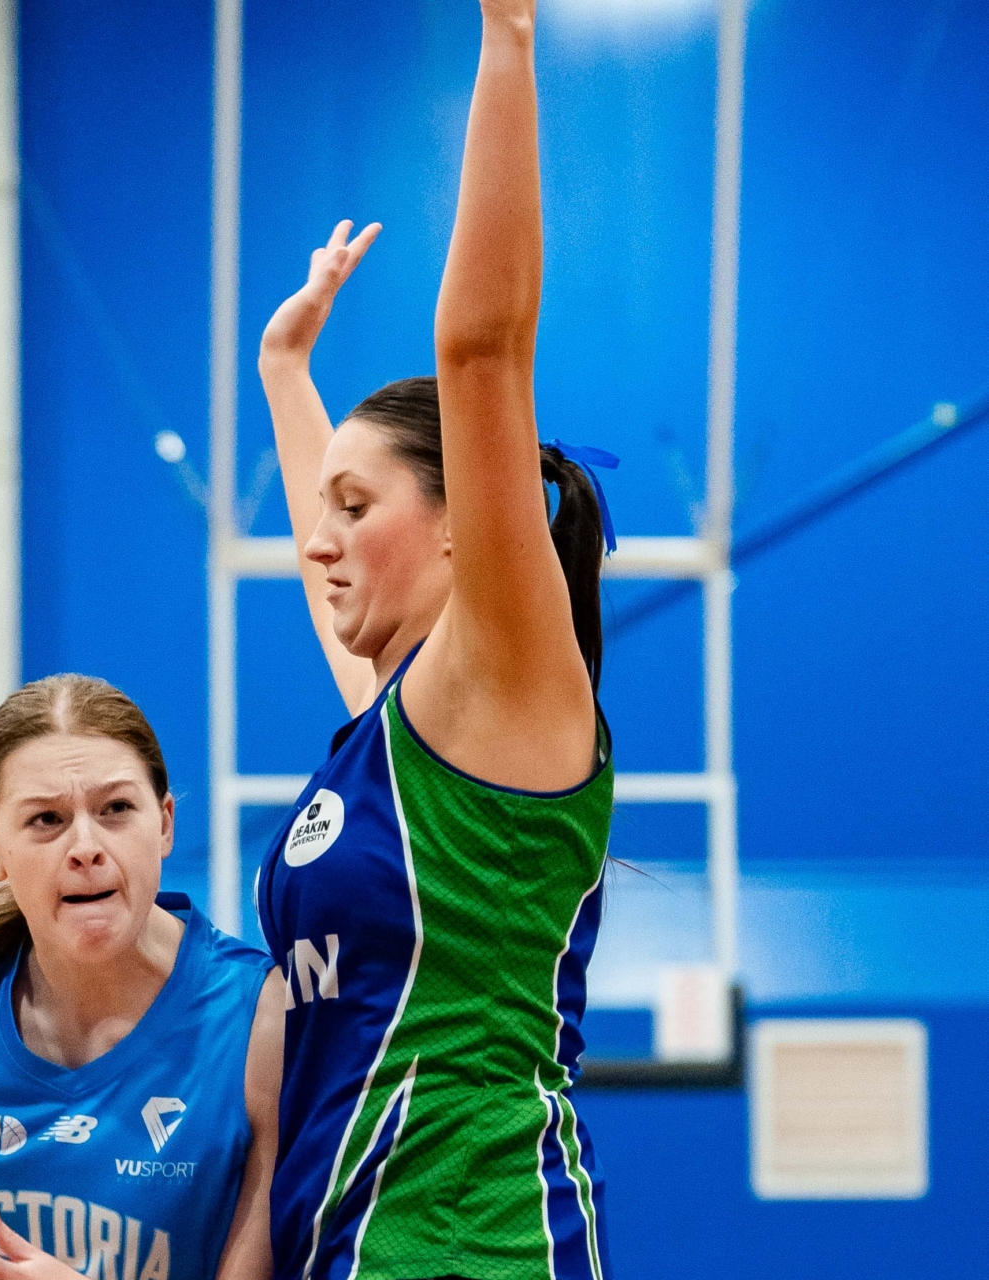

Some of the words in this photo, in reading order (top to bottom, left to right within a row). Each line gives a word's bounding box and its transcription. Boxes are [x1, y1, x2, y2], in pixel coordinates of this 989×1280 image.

[292, 819, 331, 841] DEAKIN
[289, 832, 327, 850] UNIVERSITY
[115, 1158, 198, 1178] VUSPORT
